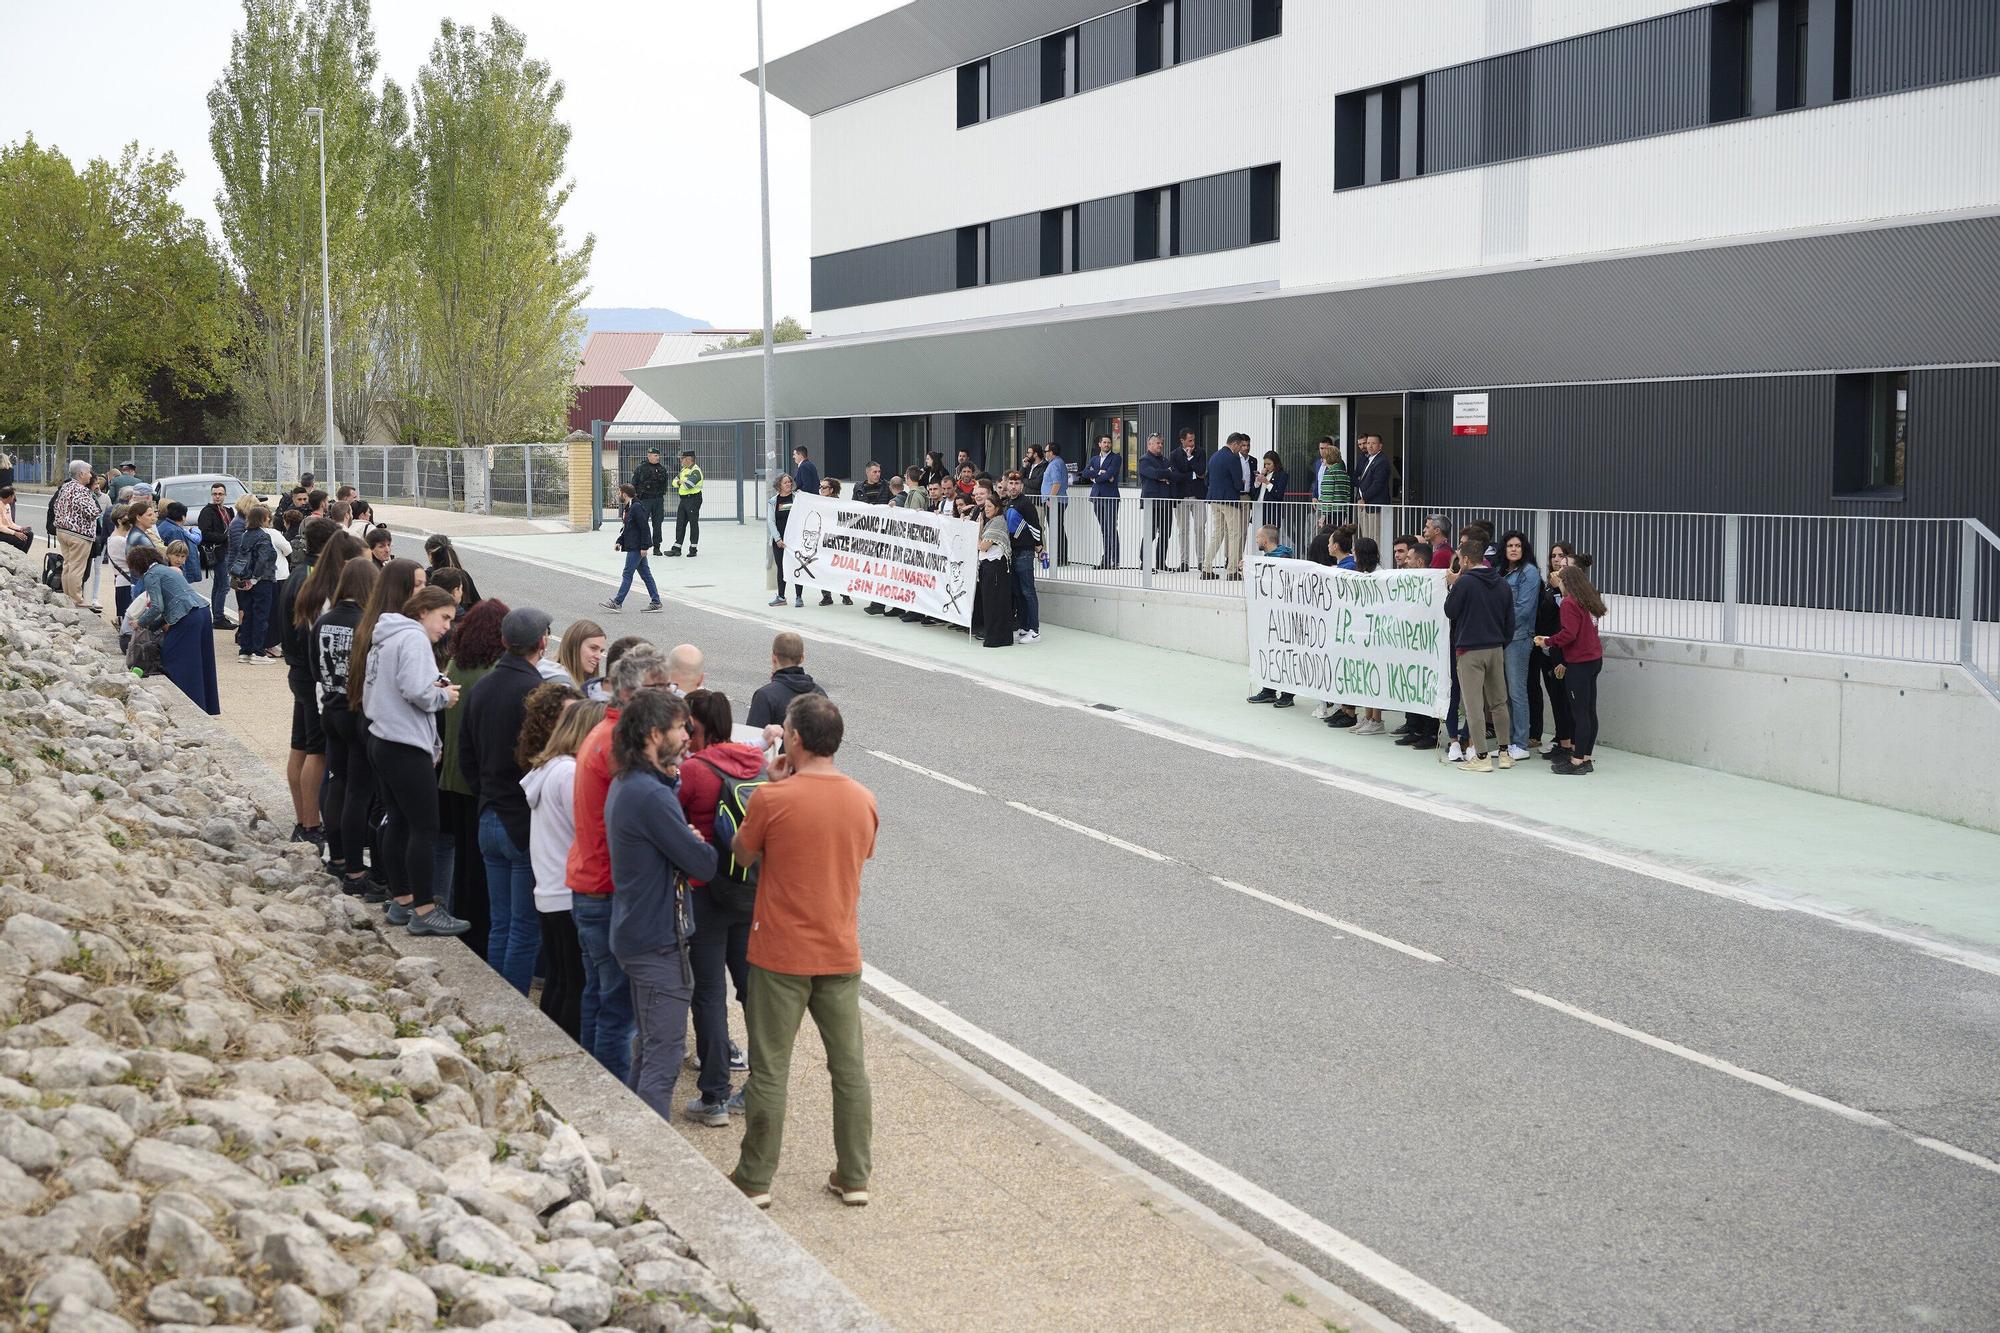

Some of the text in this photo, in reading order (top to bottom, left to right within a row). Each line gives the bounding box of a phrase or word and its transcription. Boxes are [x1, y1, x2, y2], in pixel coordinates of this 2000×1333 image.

[830, 554, 936, 590] DUAL A LA NAVARRA
[847, 577, 916, 604] ¿SIN HORAS?
[1255, 563, 1333, 611] FCT SIN HORAS
[1386, 574, 1433, 607] GABEKO
[1363, 613, 1440, 659] JARRAIPENIK
[1259, 649, 1332, 693] DESATENDIDO
[1335, 657, 1381, 697] GABEKO
